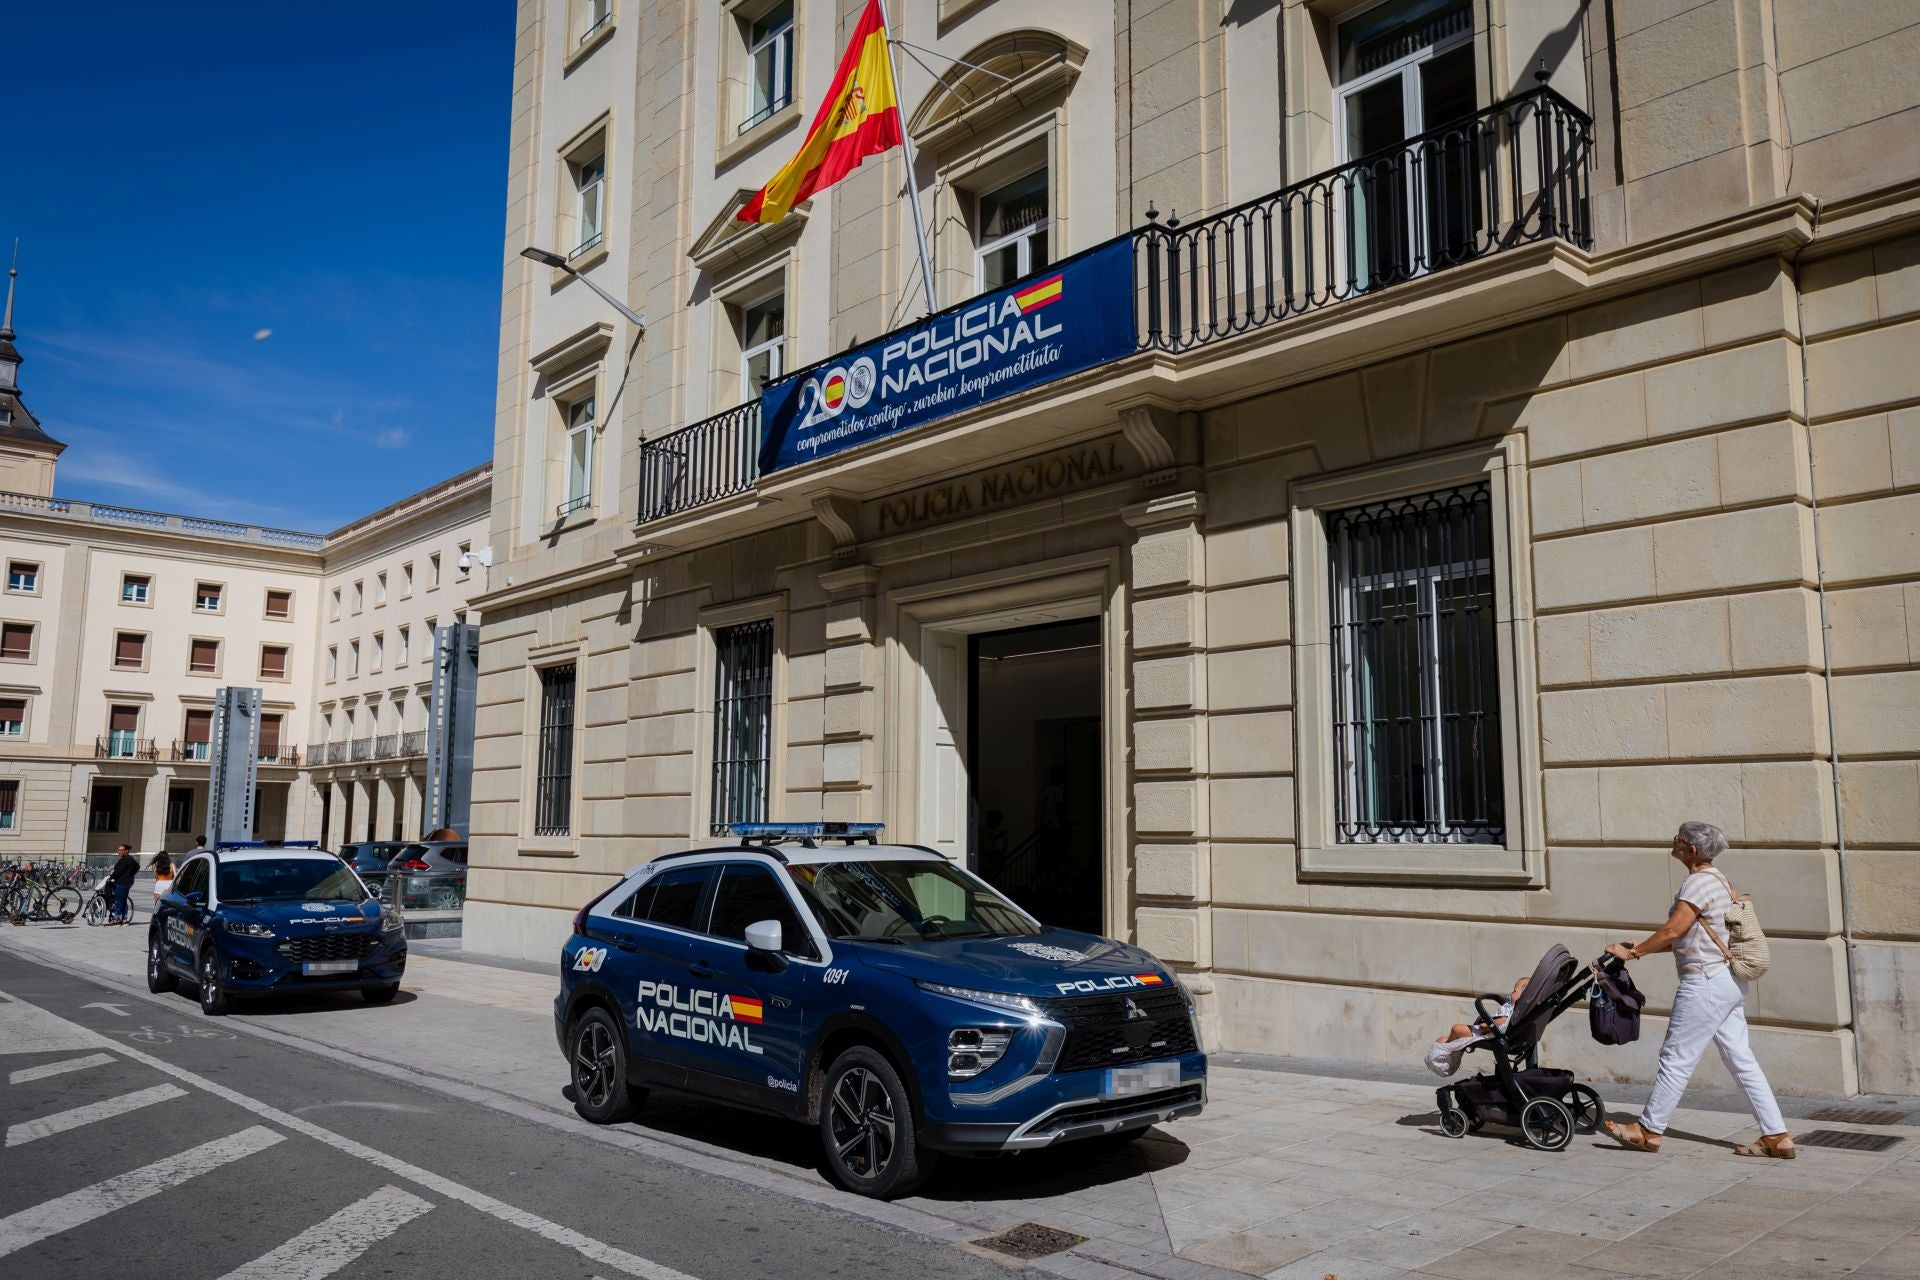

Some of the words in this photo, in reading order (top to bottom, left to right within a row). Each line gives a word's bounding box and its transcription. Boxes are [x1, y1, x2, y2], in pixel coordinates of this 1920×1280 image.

[798, 357, 876, 430] 200
[881, 314, 1062, 399] NACIONAL
[797, 415, 868, 454] comprometidos
[867, 402, 907, 428] contigo
[913, 383, 957, 411] zurekin
[958, 344, 1063, 397] konprometituta
[878, 483, 973, 531] POLICIA
[981, 443, 1124, 506] NACIONAL
[636, 1006, 764, 1055] NACIONAL
[767, 1075, 798, 1092] @policia
